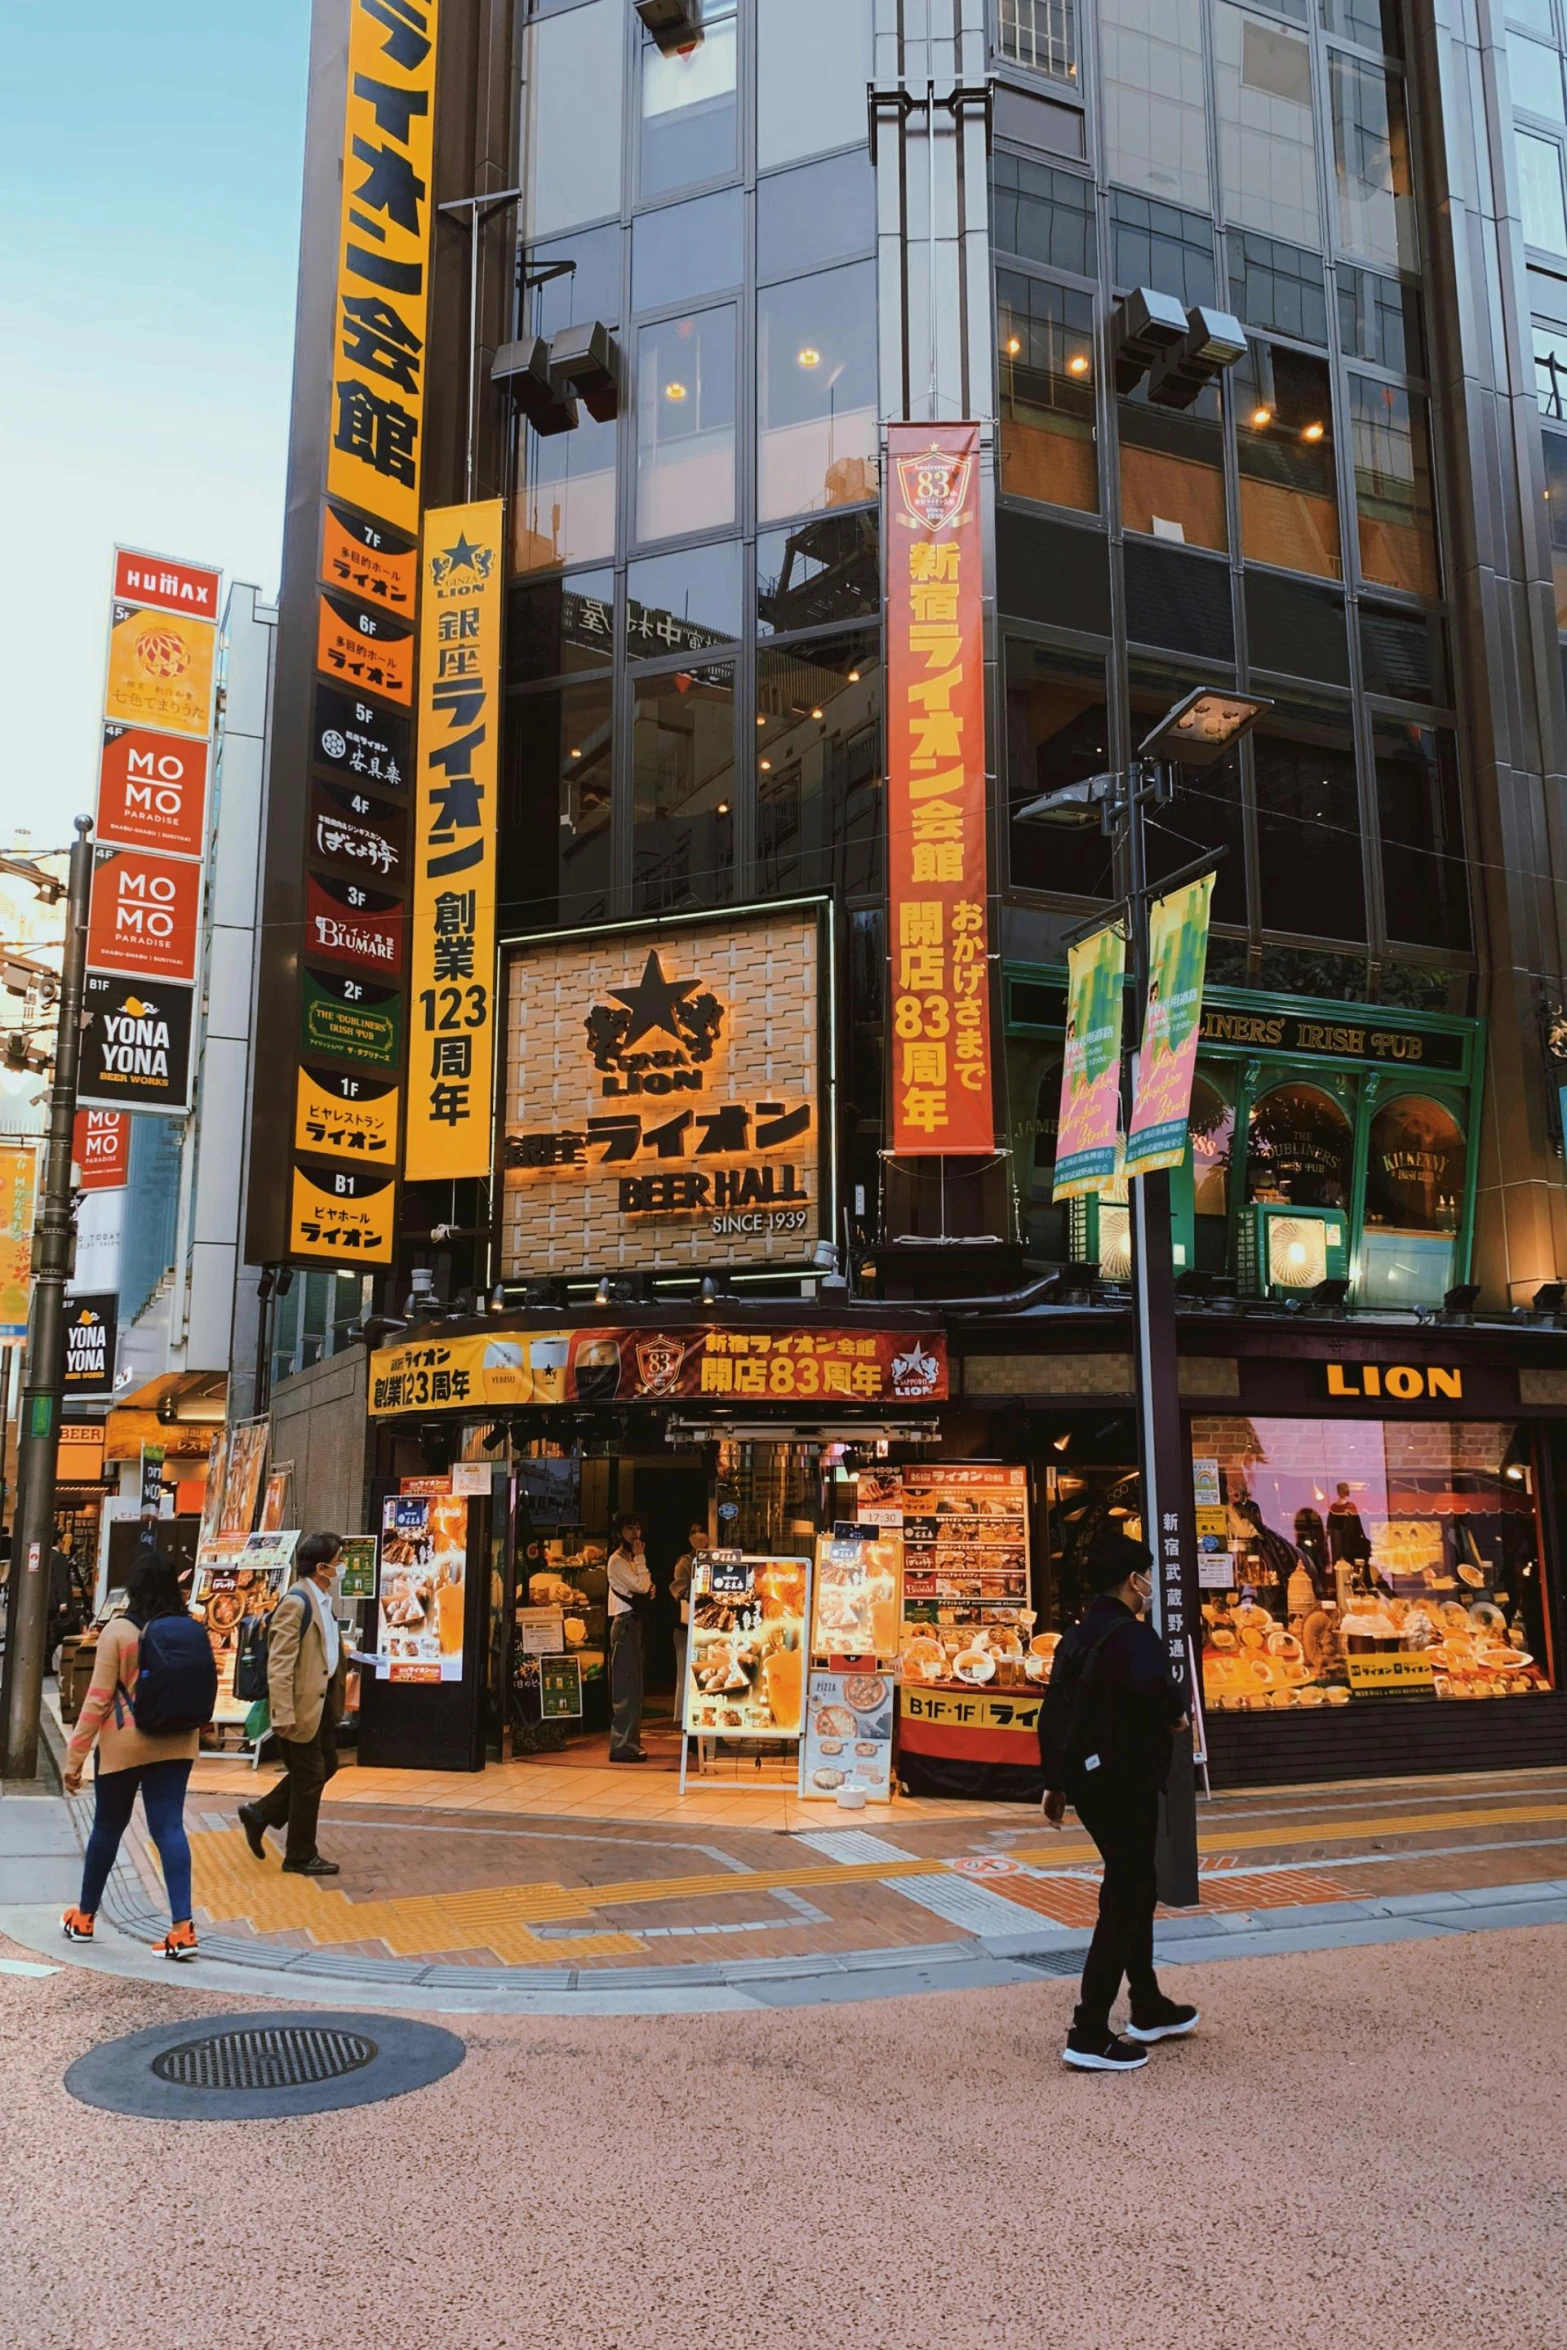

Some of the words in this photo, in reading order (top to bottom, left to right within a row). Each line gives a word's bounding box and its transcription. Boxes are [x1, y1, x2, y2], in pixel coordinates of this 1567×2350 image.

[334, 0, 432, 491] ライオン会館
[917, 470, 950, 498] 83
[363, 526, 381, 548] 7F
[340, 546, 401, 581] 多目的ホール
[333, 558, 407, 602] ライオン
[437, 583, 485, 599] LION
[445, 576, 478, 588] GINZA
[115, 607, 130, 620] 5F
[359, 614, 377, 635] 6F
[335, 635, 397, 669] 多目的ホール
[328, 648, 403, 689] ライオン
[111, 689, 205, 720] 七色てまりうた
[355, 703, 373, 724] 5F
[908, 541, 964, 883] 新宿ライオン会館
[105, 726, 123, 737] 4F
[427, 607, 487, 879] 銀座ライオン
[127, 749, 184, 780] MO
[125, 784, 181, 815] MO
[351, 795, 370, 814] 4F
[124, 809, 179, 826] PARADISE
[96, 849, 114, 860] 4F
[118, 871, 176, 902] MO
[348, 886, 366, 907] 3F
[116, 906, 174, 937] MO
[115, 933, 172, 949] PARADISE
[89, 978, 110, 991] B1F
[344, 980, 363, 1000] 2F
[951, 899, 986, 1091] おかげさまで
[315, 1009, 334, 1021] THE
[420, 889, 487, 1127] 創業123周年
[895, 900, 950, 1133] 開店83周年
[103, 1015, 170, 1049] YONA
[329, 1023, 353, 1036] IRISH
[355, 1028, 375, 1041] PUB
[1199, 1013, 1285, 1044] INERS'
[1296, 1023, 1364, 1053] IRISH
[1371, 1033, 1423, 1060] PUB
[101, 1044, 169, 1077] YONA
[617, 1049, 690, 1073] GINZA
[100, 1072, 128, 1084] BEER
[130, 1075, 169, 1087] WORKS
[341, 1077, 359, 1097] 1F
[602, 1069, 703, 1098] LION
[87, 1110, 120, 1129] MO
[309, 1104, 385, 1129] ビヤレストラン
[86, 1135, 118, 1156] MO
[306, 1121, 386, 1151] ライオン
[1293, 1131, 1312, 1141] THE
[85, 1155, 117, 1164] PARADISE
[1305, 1163, 1325, 1174] PUB
[1382, 1151, 1449, 1175] KILKENNY
[335, 1174, 354, 1195] B1
[619, 1172, 711, 1213] BEER
[714, 1164, 808, 1206] HALL
[314, 1206, 370, 1225] ビヤホール
[712, 1213, 763, 1234] SINCE
[767, 1211, 807, 1230] 1939
[301, 1222, 382, 1248] ライオン
[68, 1326, 106, 1349] YONA
[705, 1334, 876, 1357] 新宿ライオン会館
[66, 1349, 105, 1372] YONA
[649, 1352, 669, 1372] 83
[491, 1376, 515, 1384] YEBISU
[700, 1357, 883, 1396] 開店83周年
[1327, 1364, 1462, 1399] LION
[60, 1427, 101, 1440] BEER
[164, 1427, 213, 1437] Restaura
[868, 1513, 896, 1523] 17:30
[1163, 1512, 1184, 1684] 新宿武蔵野通り
[816, 1682, 836, 1692] PIZZA
[989, 1703, 1039, 1727] ライ
